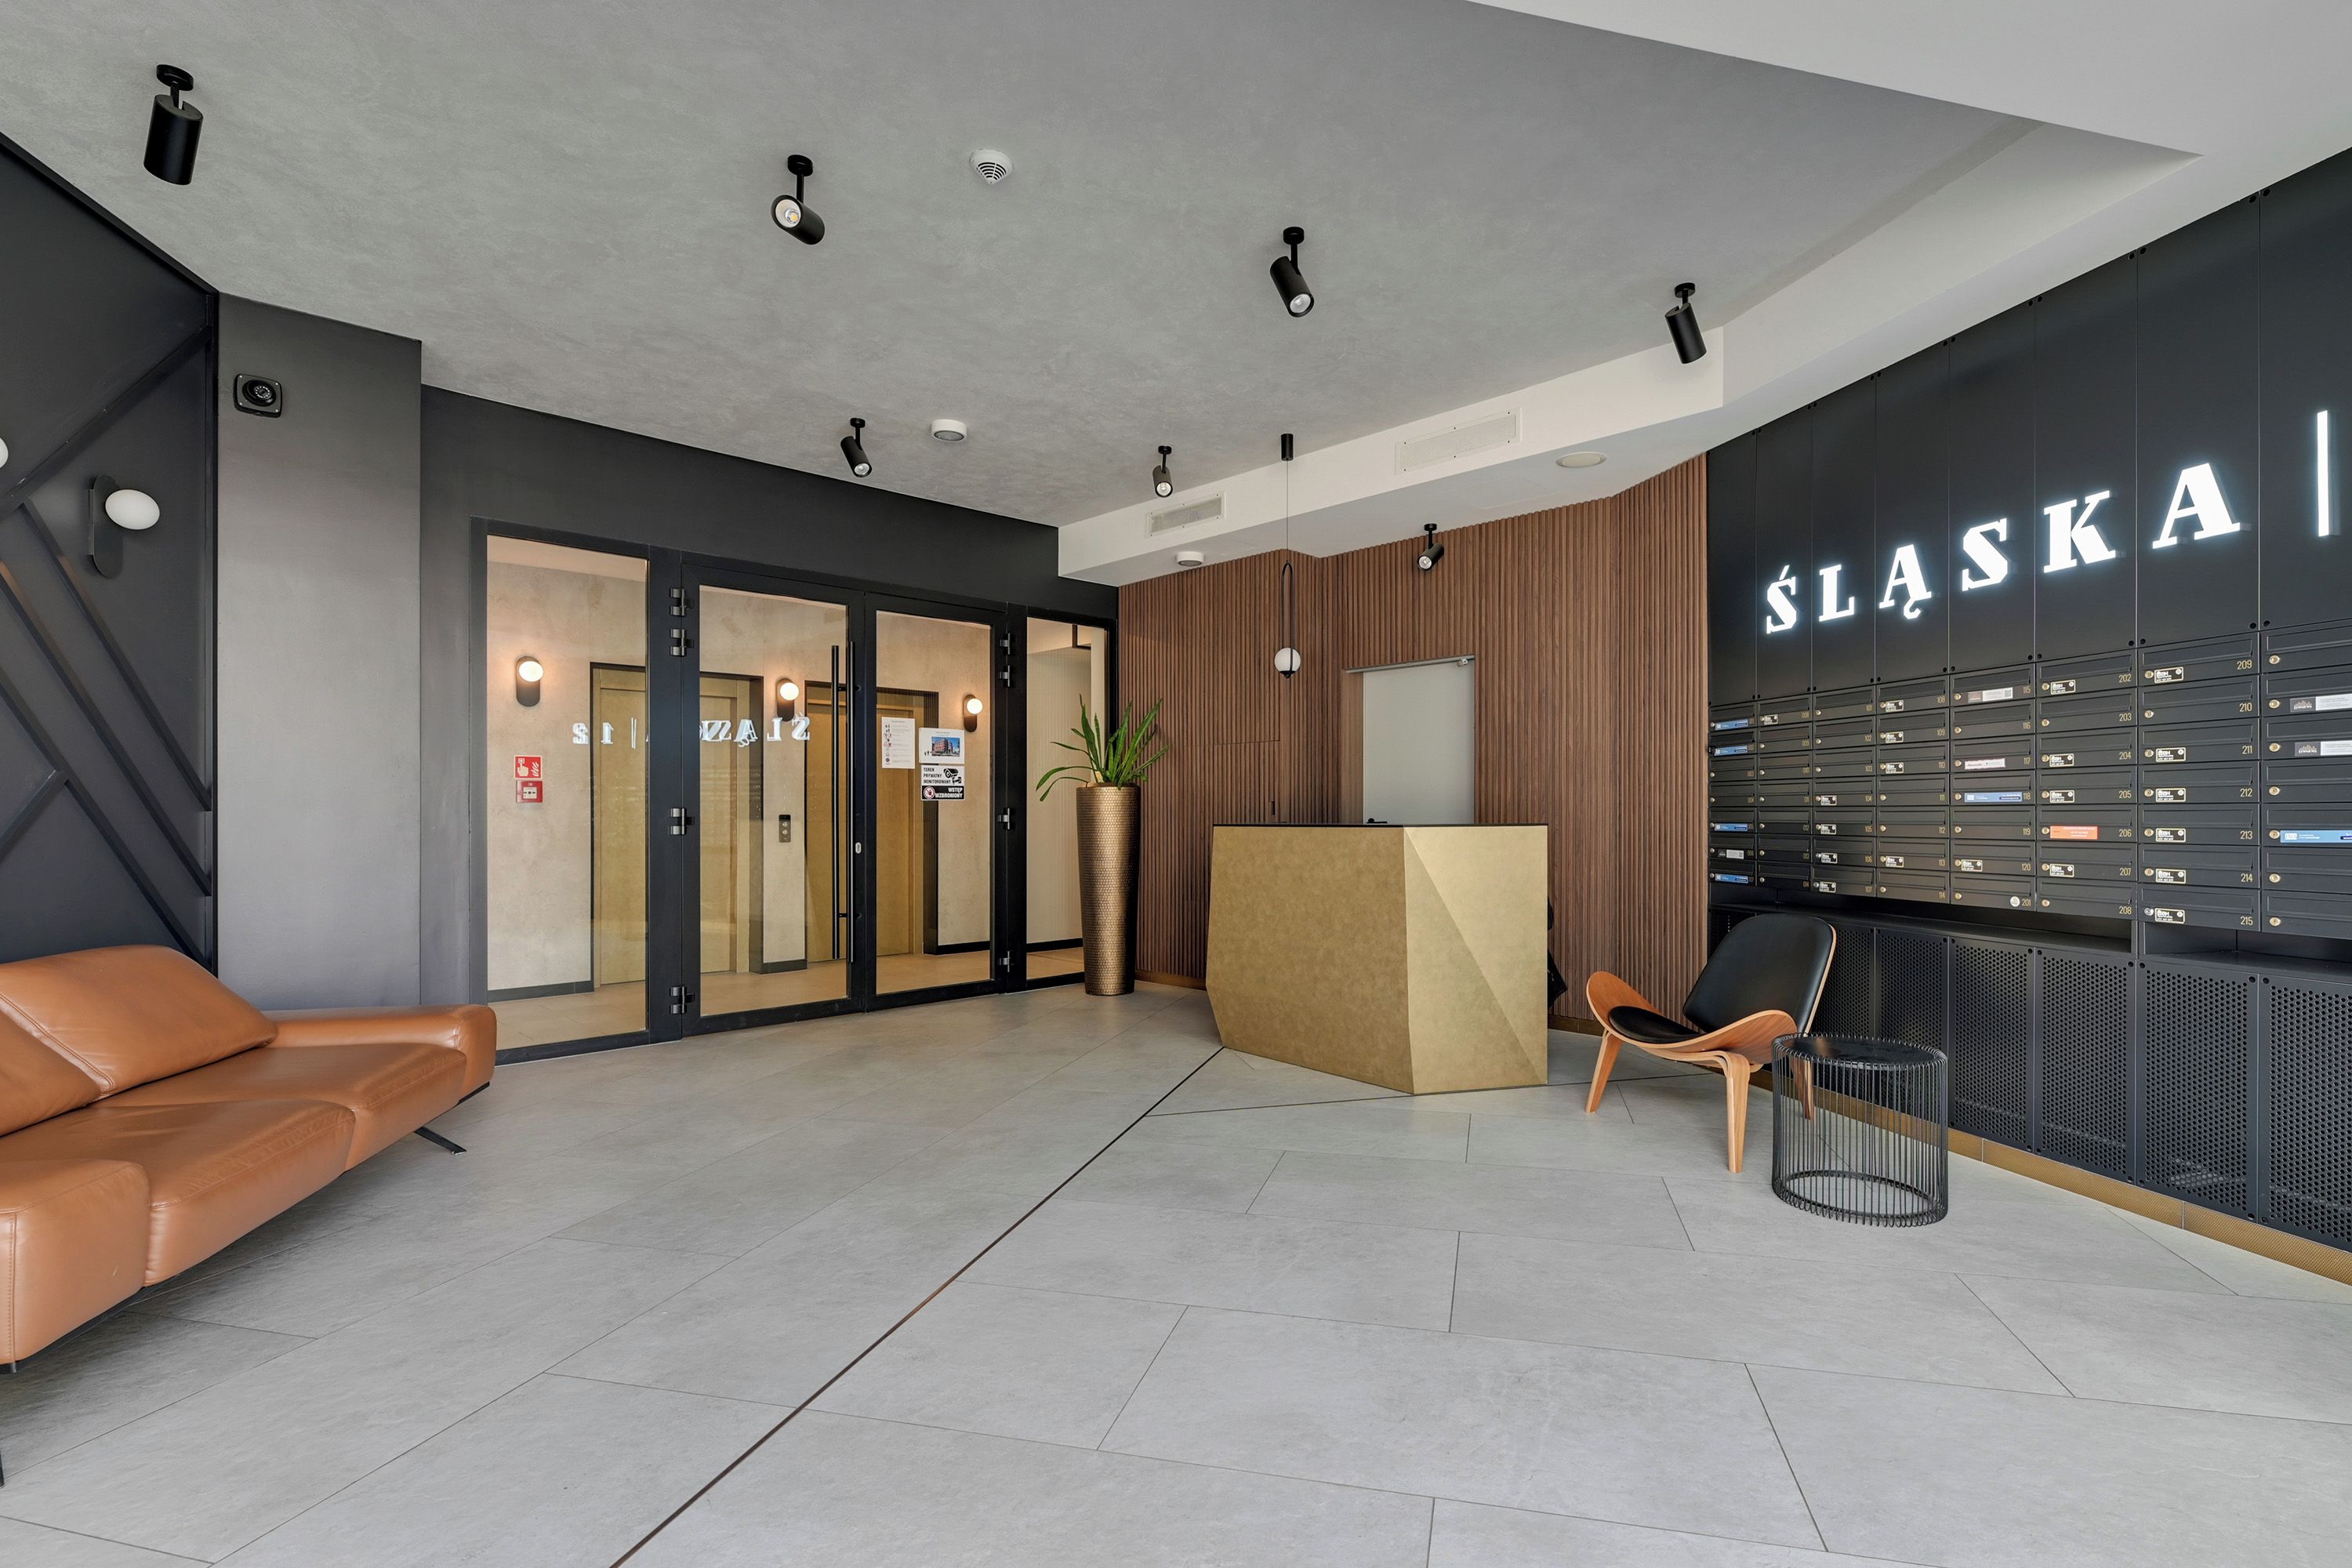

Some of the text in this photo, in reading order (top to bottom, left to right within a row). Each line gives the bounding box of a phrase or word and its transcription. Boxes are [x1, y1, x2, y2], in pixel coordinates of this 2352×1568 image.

[1766, 462, 2242, 634] ŚLĄSKA
[2237, 660, 2252, 670] 209
[2118, 674, 2132, 683] 202
[2239, 702, 2252, 712] 210
[2119, 713, 2132, 721] 203
[2241, 746, 2252, 754] 211
[2118, 790, 2132, 799] 205
[2240, 789, 2252, 797] 212
[2119, 829, 2132, 837] 206
[2240, 830, 2252, 840] 213
[2119, 867, 2132, 876] 207
[2241, 873, 2252, 882] 214
[2119, 906, 2132, 915] 208
[2240, 916, 2252, 926] 215
